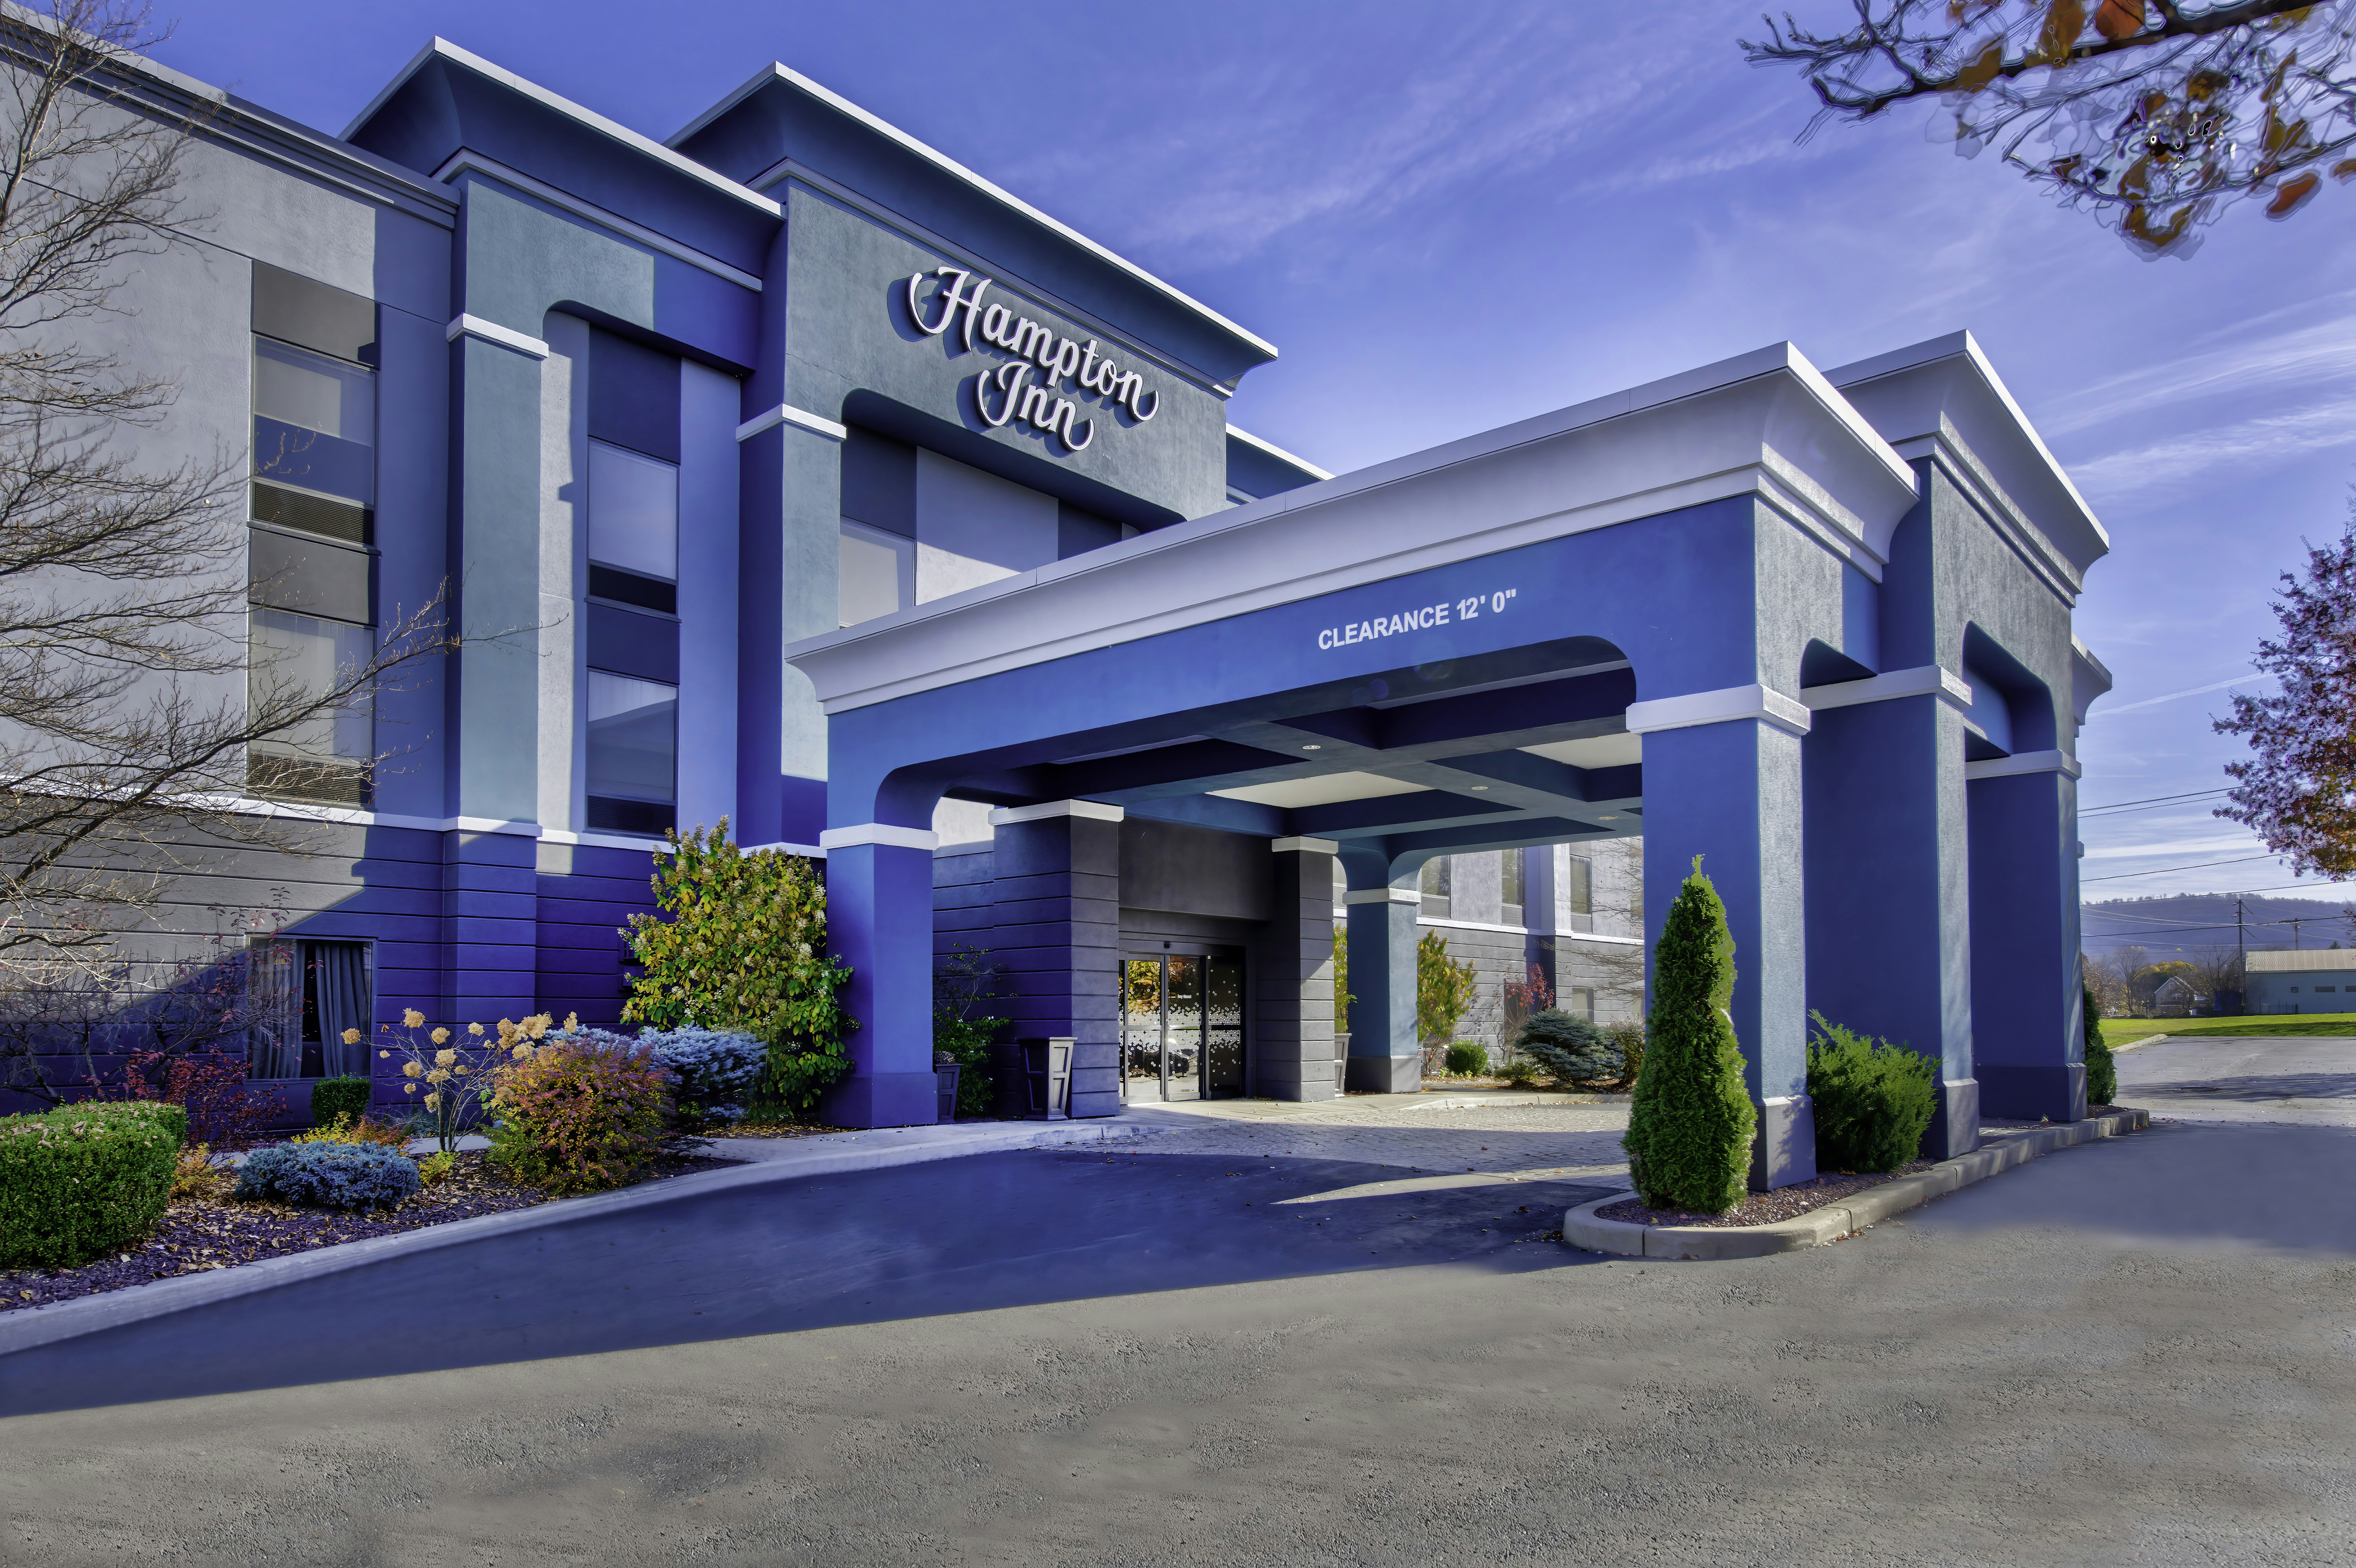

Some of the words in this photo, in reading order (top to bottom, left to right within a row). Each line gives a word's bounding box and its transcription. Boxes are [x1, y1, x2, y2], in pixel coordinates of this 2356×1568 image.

[908, 266, 1160, 422] Hampton
[975, 360, 1094, 451] Inn
[1318, 603, 1449, 650] CLEARANCE
[1456, 595, 1485, 620] 12'
[1492, 588, 1516, 613] 0"
